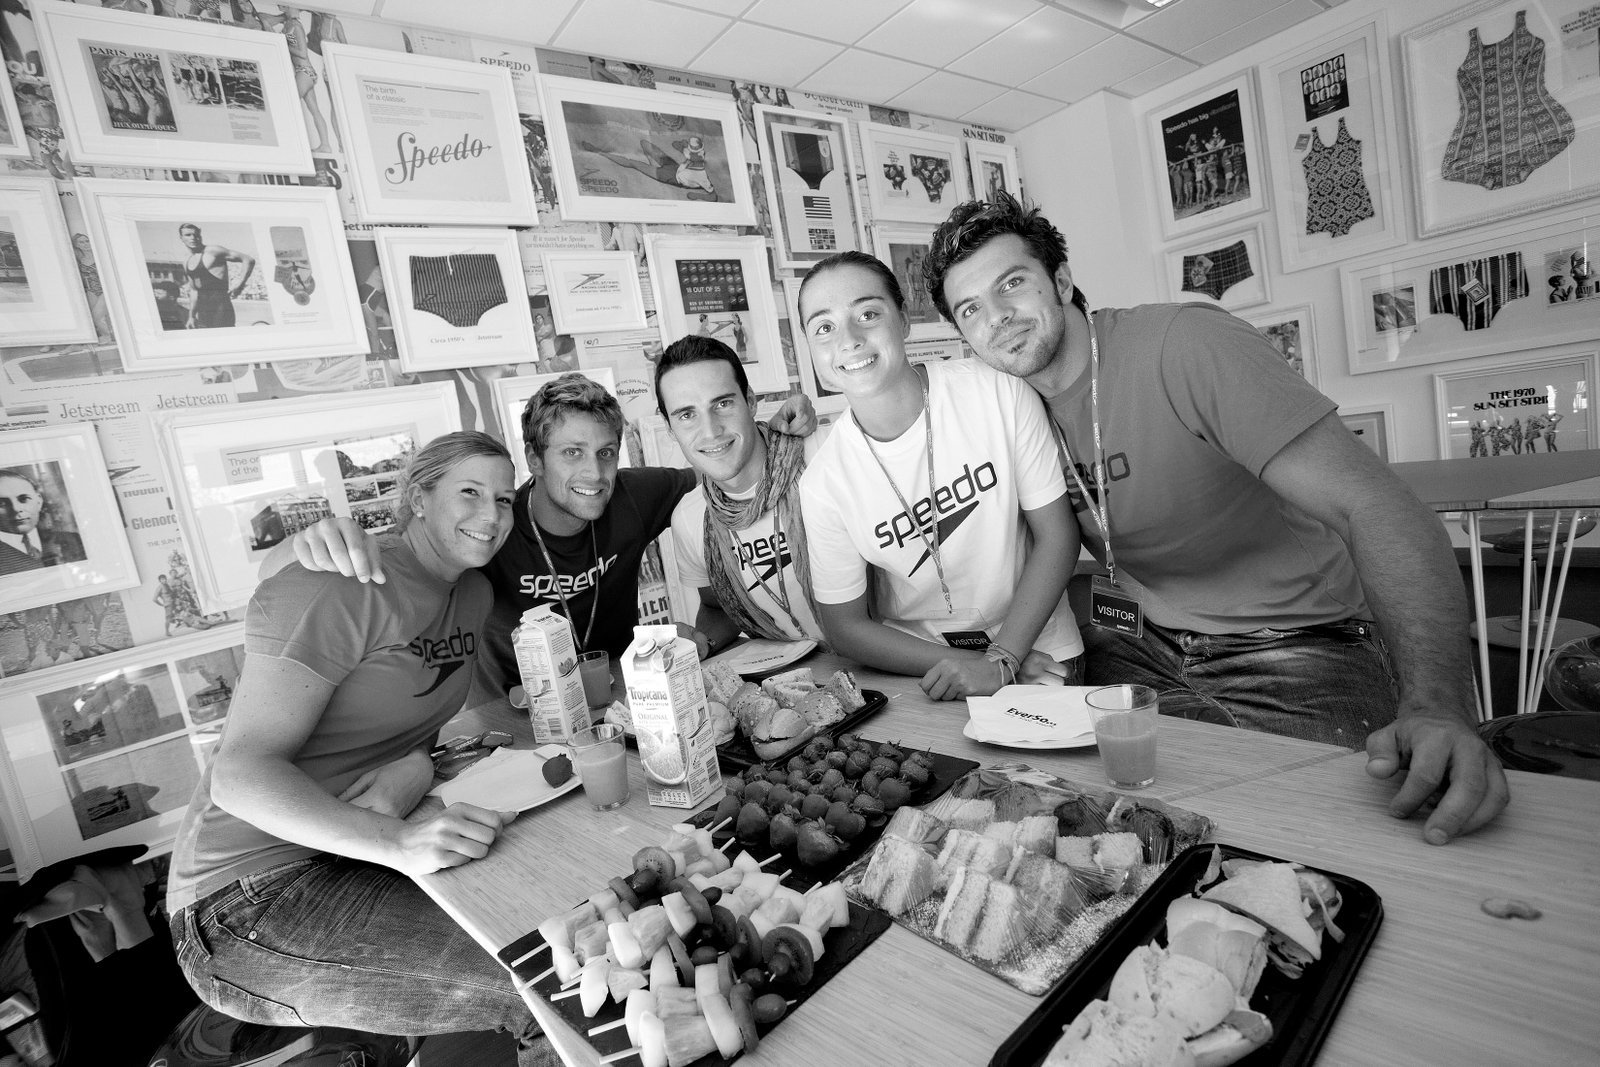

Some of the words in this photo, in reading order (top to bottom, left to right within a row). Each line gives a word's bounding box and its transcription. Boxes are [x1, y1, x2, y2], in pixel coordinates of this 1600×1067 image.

[89, 46, 127, 56] PARIS
[480, 57, 532, 72] SPEEDO
[380, 86, 397, 94] birth
[1165, 121, 1188, 133] Speedo
[385, 131, 484, 184] Speedo
[580, 178, 618, 187] SPEEDO
[581, 185, 620, 194] SPEEDO
[156, 391, 229, 409] Jetstream
[1488, 390, 1512, 401] THE
[1513, 387, 1536, 399] 1970
[59, 401, 142, 419] Jetstream
[1473, 401, 1497, 411] SUN
[1498, 398, 1519, 409] SET
[227, 458, 248, 466] The
[231, 467, 241, 476] of
[243, 465, 259, 474] the
[874, 461, 998, 549] speedo
[1097, 604, 1136, 623] VISITOR
[950, 638, 991, 646] VISITOR
[627, 687, 669, 701] Tropicana
[637, 713, 668, 721] ORIGINAL
